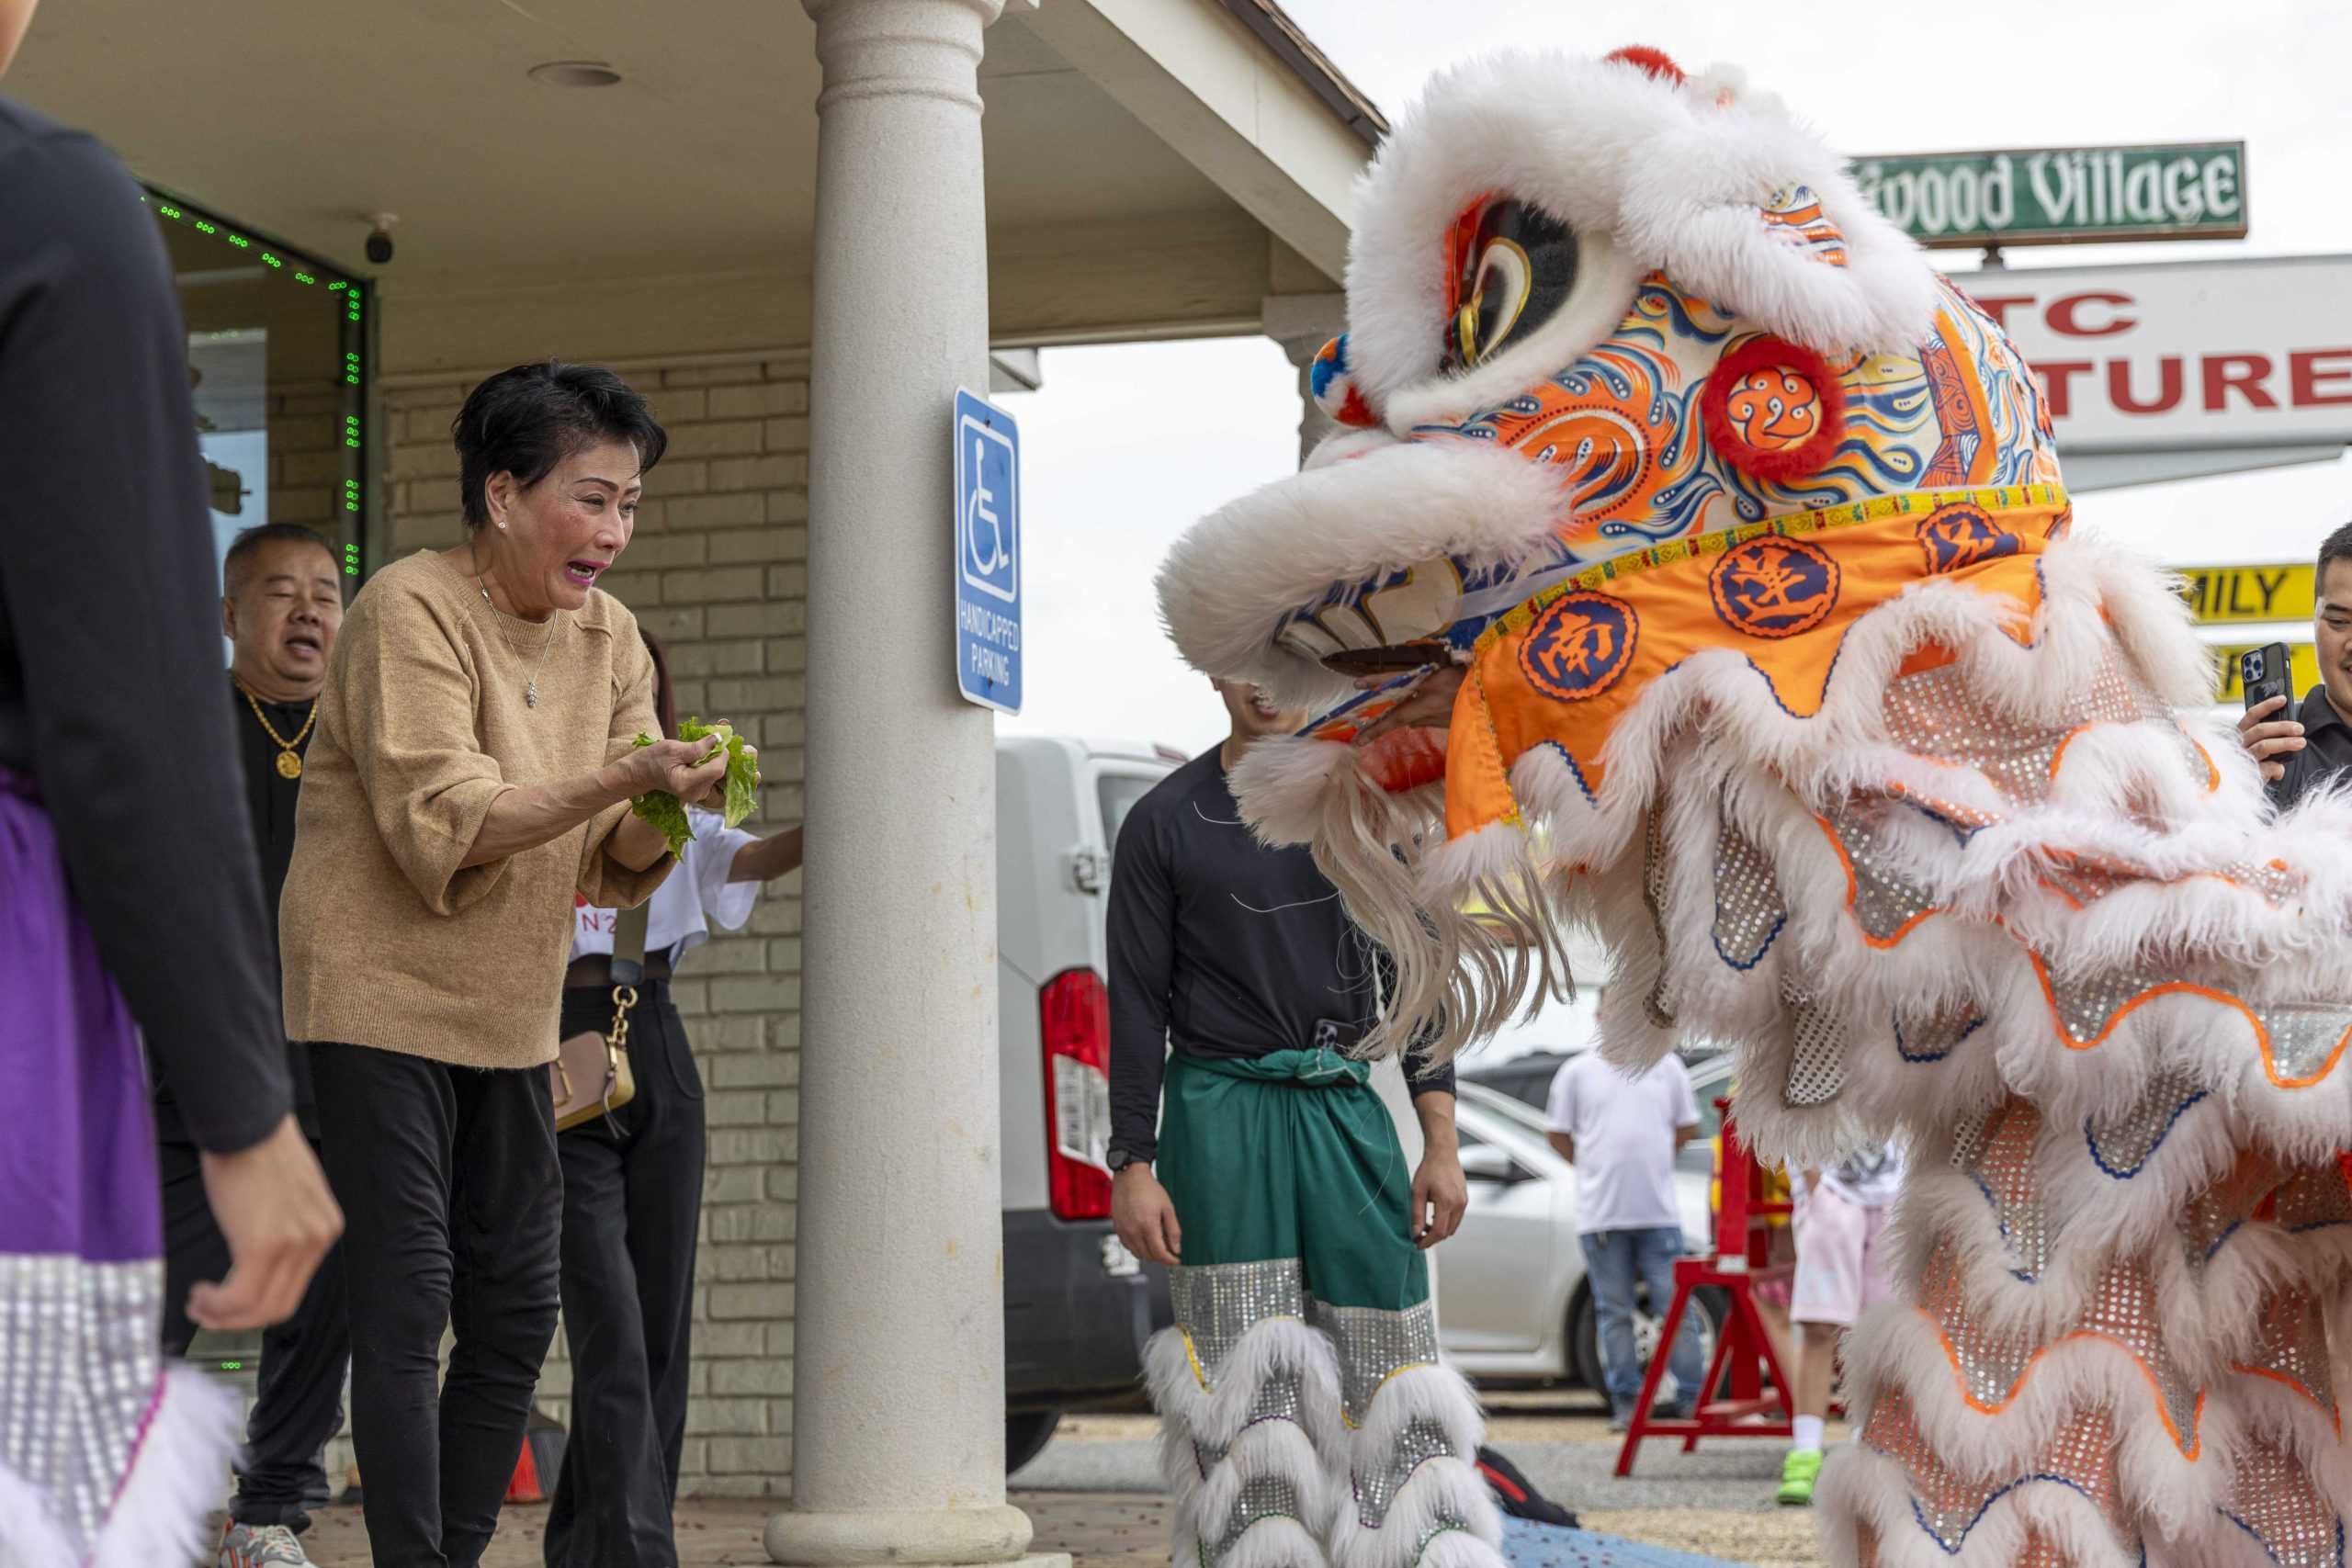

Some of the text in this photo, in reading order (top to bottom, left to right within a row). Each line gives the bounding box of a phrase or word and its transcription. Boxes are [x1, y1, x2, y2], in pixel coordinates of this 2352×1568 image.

[2027, 150, 2240, 227] Village
[2027, 346, 2352, 417] TURE
[960, 599, 1019, 651] HANDICAPPED
[971, 642, 1009, 687] PARKING
